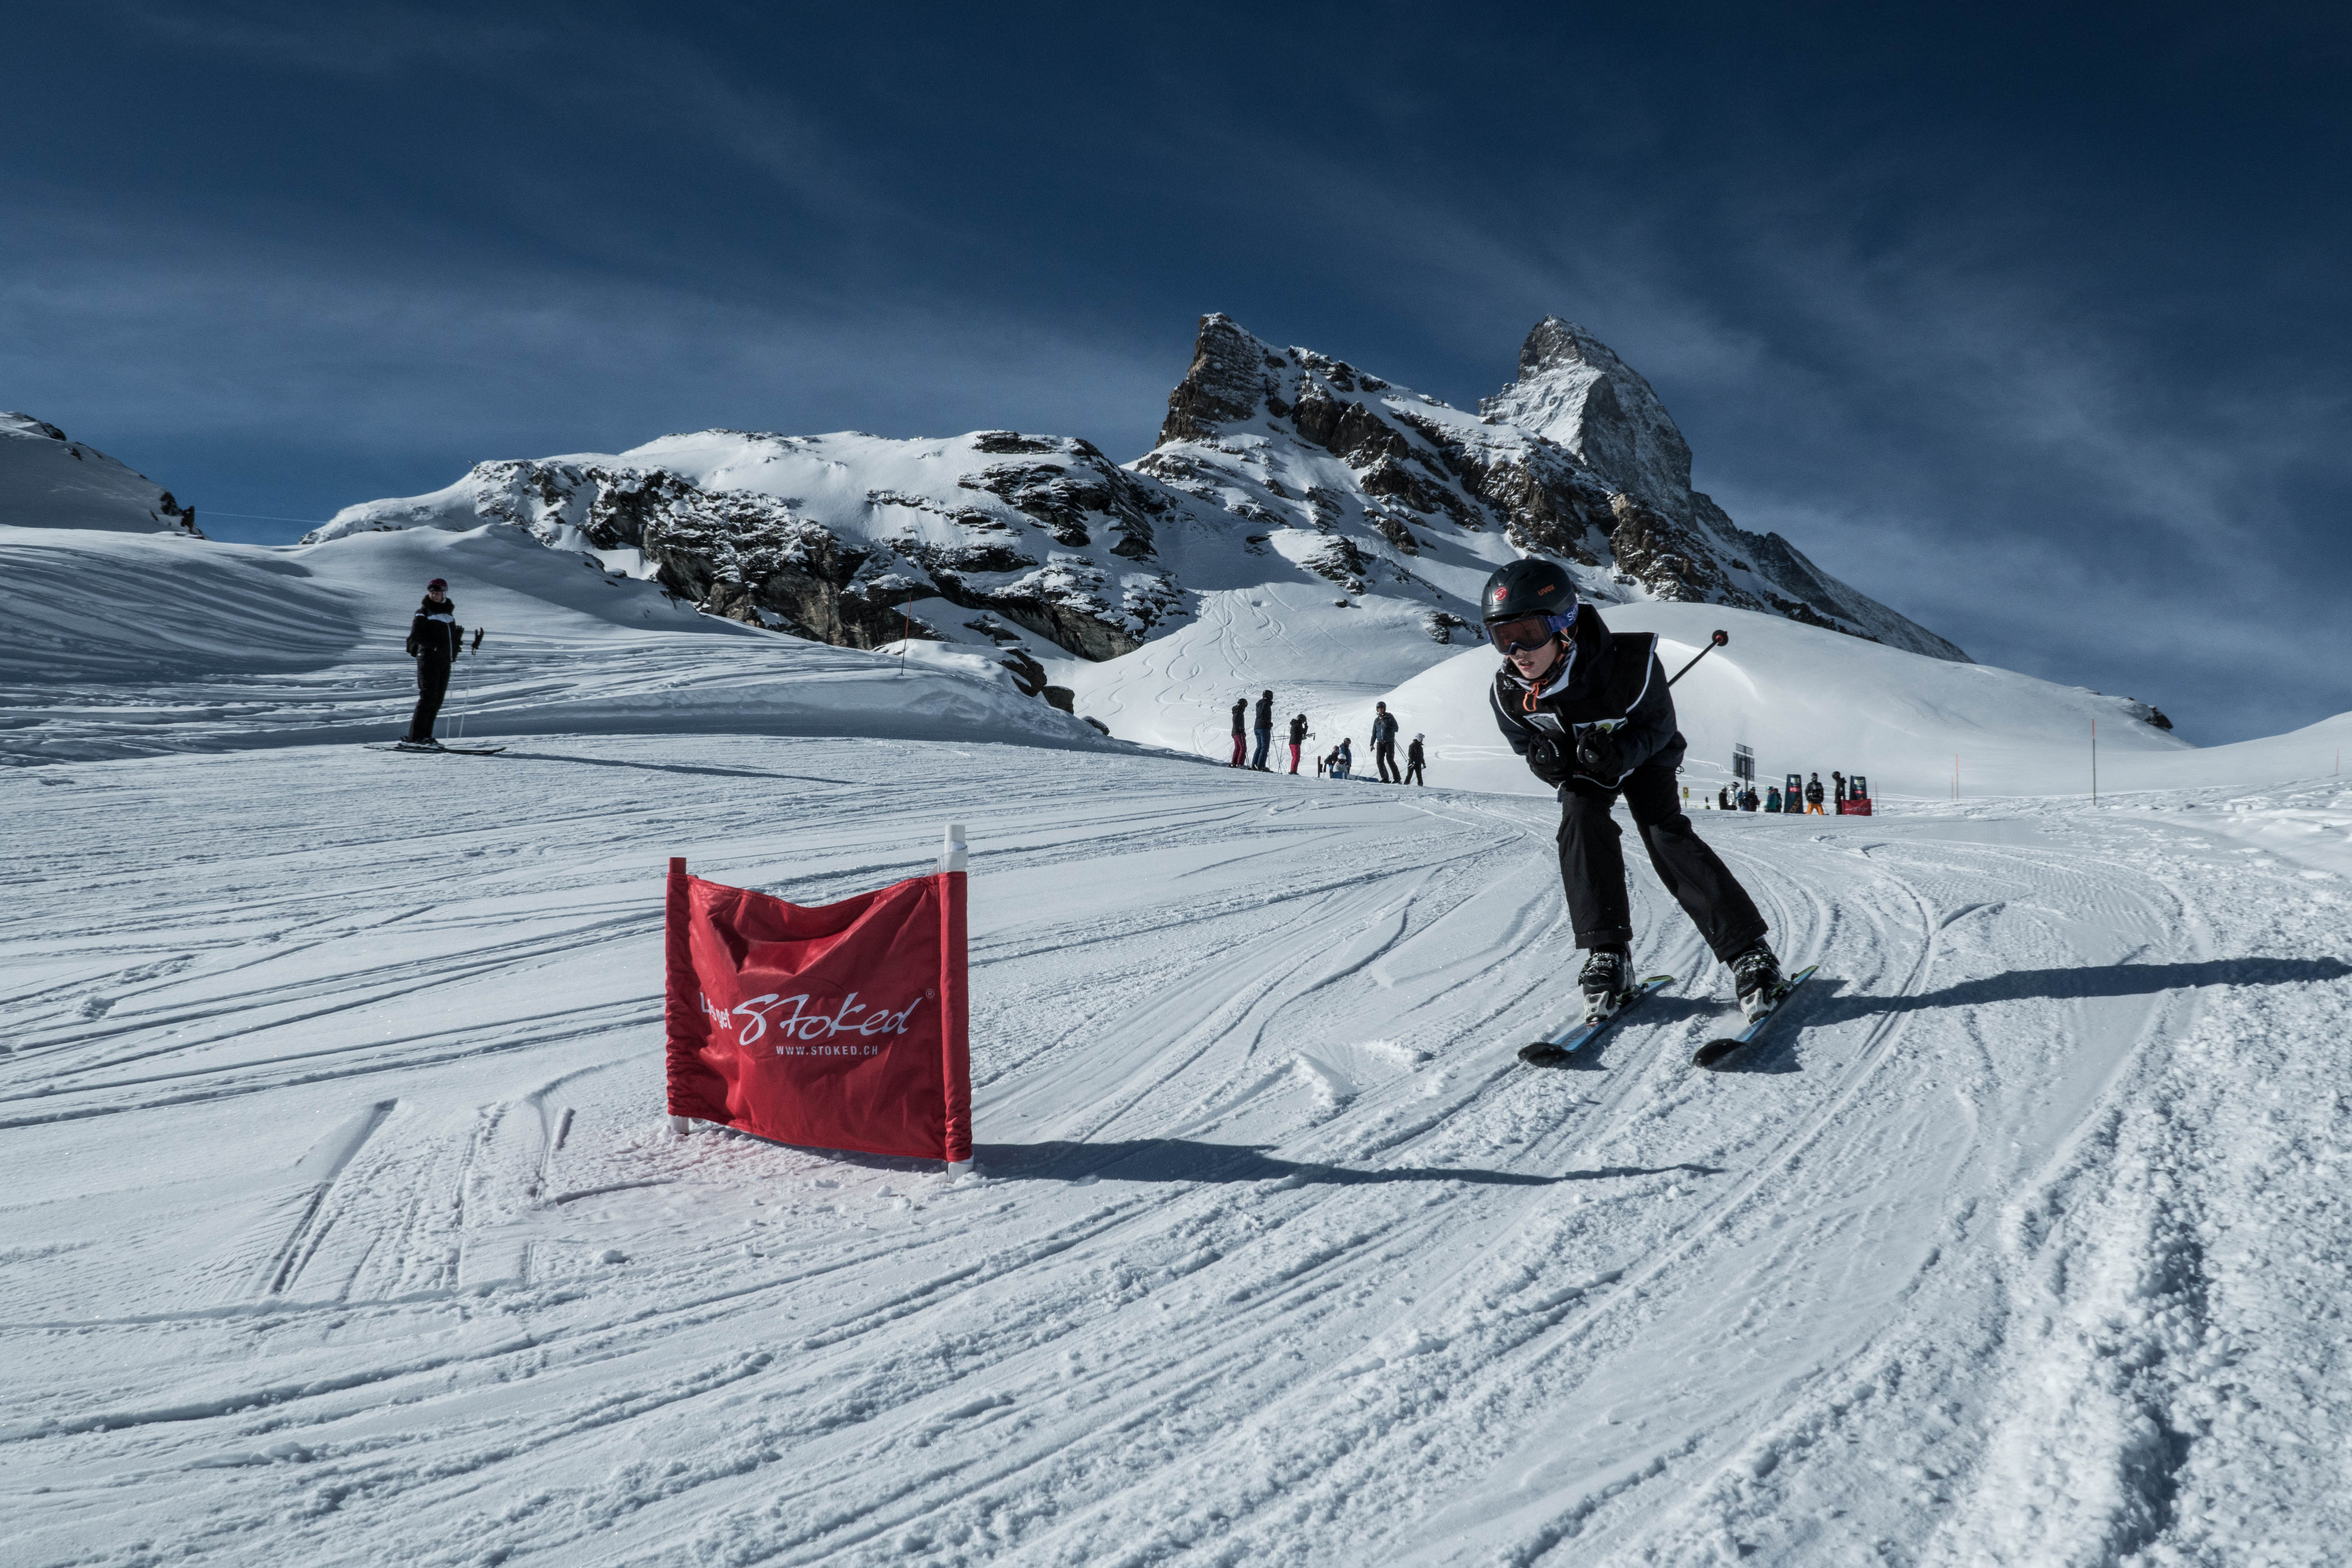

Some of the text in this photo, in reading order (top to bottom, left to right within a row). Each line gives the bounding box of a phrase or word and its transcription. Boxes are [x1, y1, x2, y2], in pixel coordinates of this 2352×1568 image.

[1537, 584, 1555, 596] uvex
[715, 1008, 733, 1030] get
[732, 991, 922, 1045] Stoked
[776, 1045, 878, 1056] WWW.STOKED.CH
